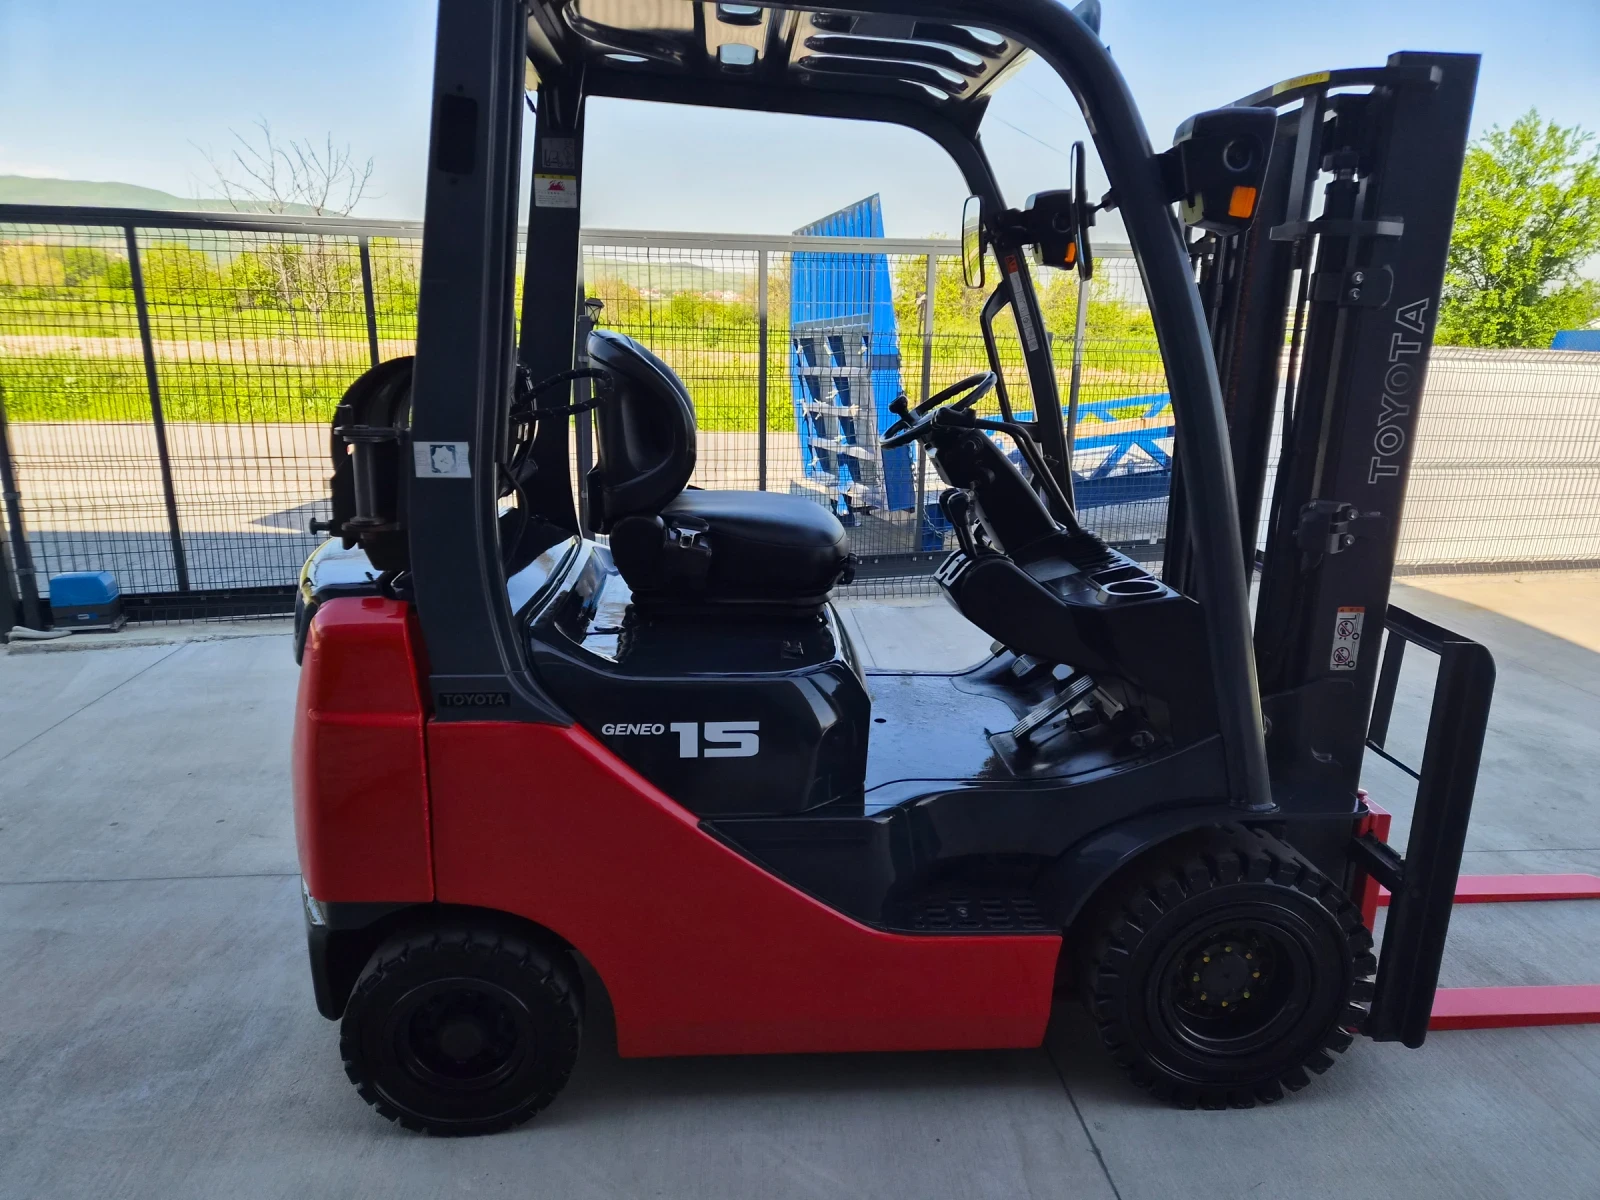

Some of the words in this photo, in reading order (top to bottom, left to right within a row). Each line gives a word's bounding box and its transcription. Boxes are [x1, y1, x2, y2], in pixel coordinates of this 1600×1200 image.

[1368, 297, 1430, 484] TOYOTA
[443, 694, 505, 706] TOYOTA
[601, 723, 665, 736] GENEO
[670, 721, 760, 759] 15
